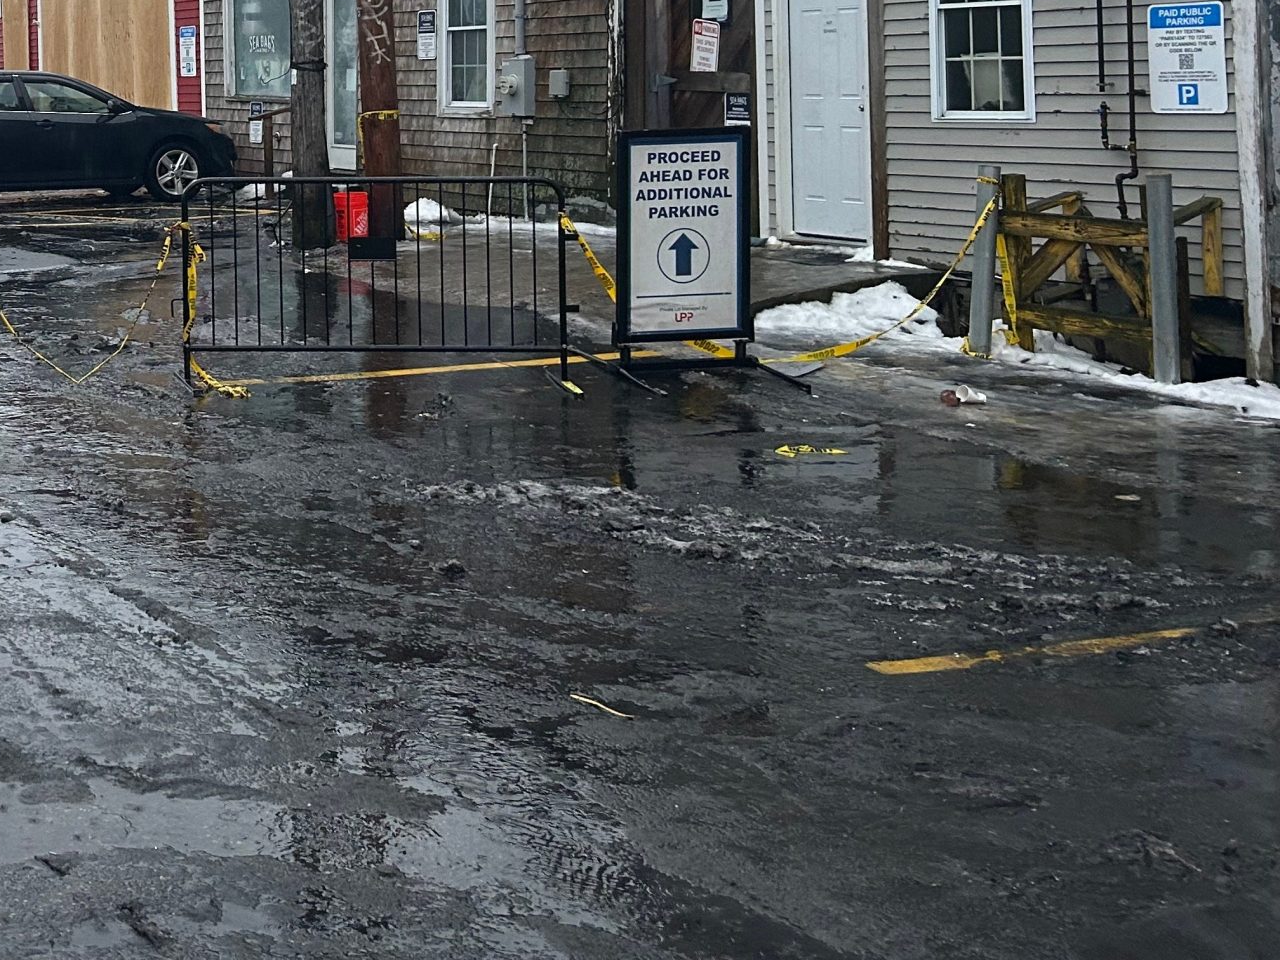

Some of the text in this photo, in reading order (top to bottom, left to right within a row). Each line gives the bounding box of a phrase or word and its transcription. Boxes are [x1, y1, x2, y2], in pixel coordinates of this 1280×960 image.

[1158, 7, 1212, 17] PAID PUBLIC
[1165, 17, 1204, 26] PARKING
[249, 35, 275, 53] SEA BAGS
[1182, 85, 1196, 104] P
[647, 150, 721, 164] PROCEED
[638, 168, 730, 183] AHEAD FOR
[635, 186, 733, 201] ADDITIONAL
[648, 204, 719, 219] PARKING
